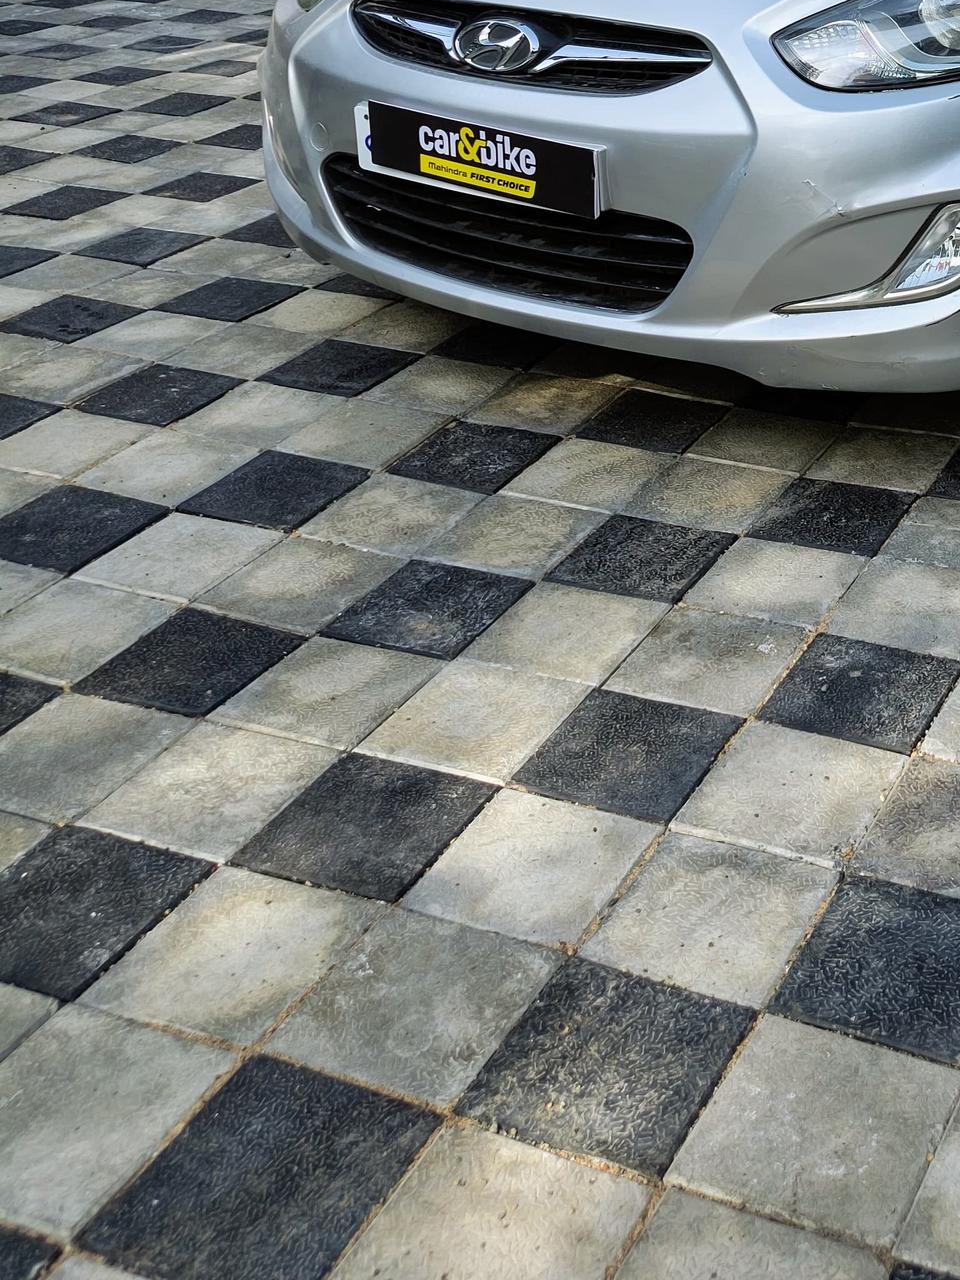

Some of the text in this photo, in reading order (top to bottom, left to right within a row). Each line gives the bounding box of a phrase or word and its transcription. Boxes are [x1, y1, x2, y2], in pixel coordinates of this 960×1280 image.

[418, 125, 537, 176] car&bike
[428, 161, 531, 193] Mahindra FIRST CHOICE
